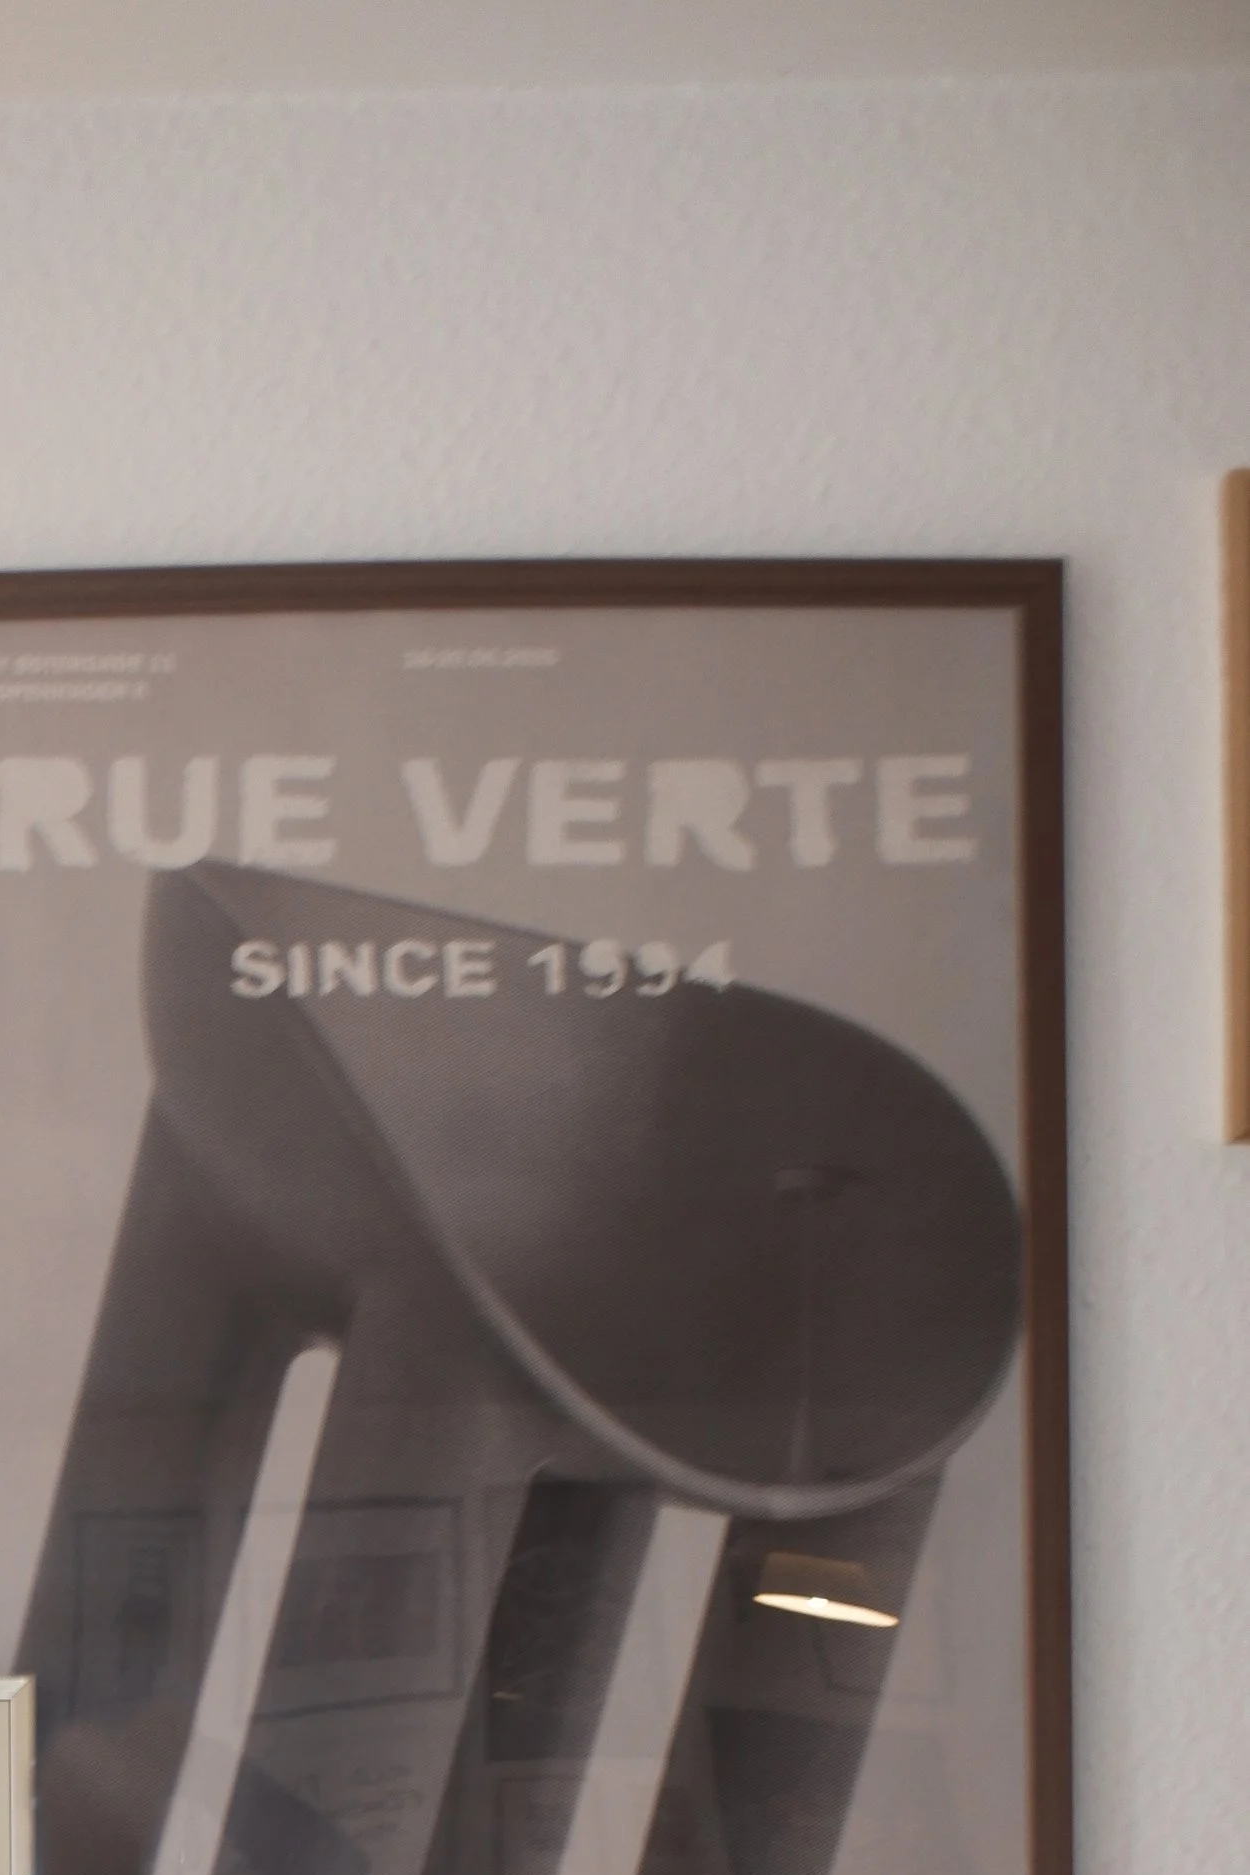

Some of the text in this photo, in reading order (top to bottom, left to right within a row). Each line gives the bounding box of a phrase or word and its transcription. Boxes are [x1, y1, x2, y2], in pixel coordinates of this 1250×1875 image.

[401, 753, 977, 870] VERTE
[231, 939, 736, 999] SINCE 1994
